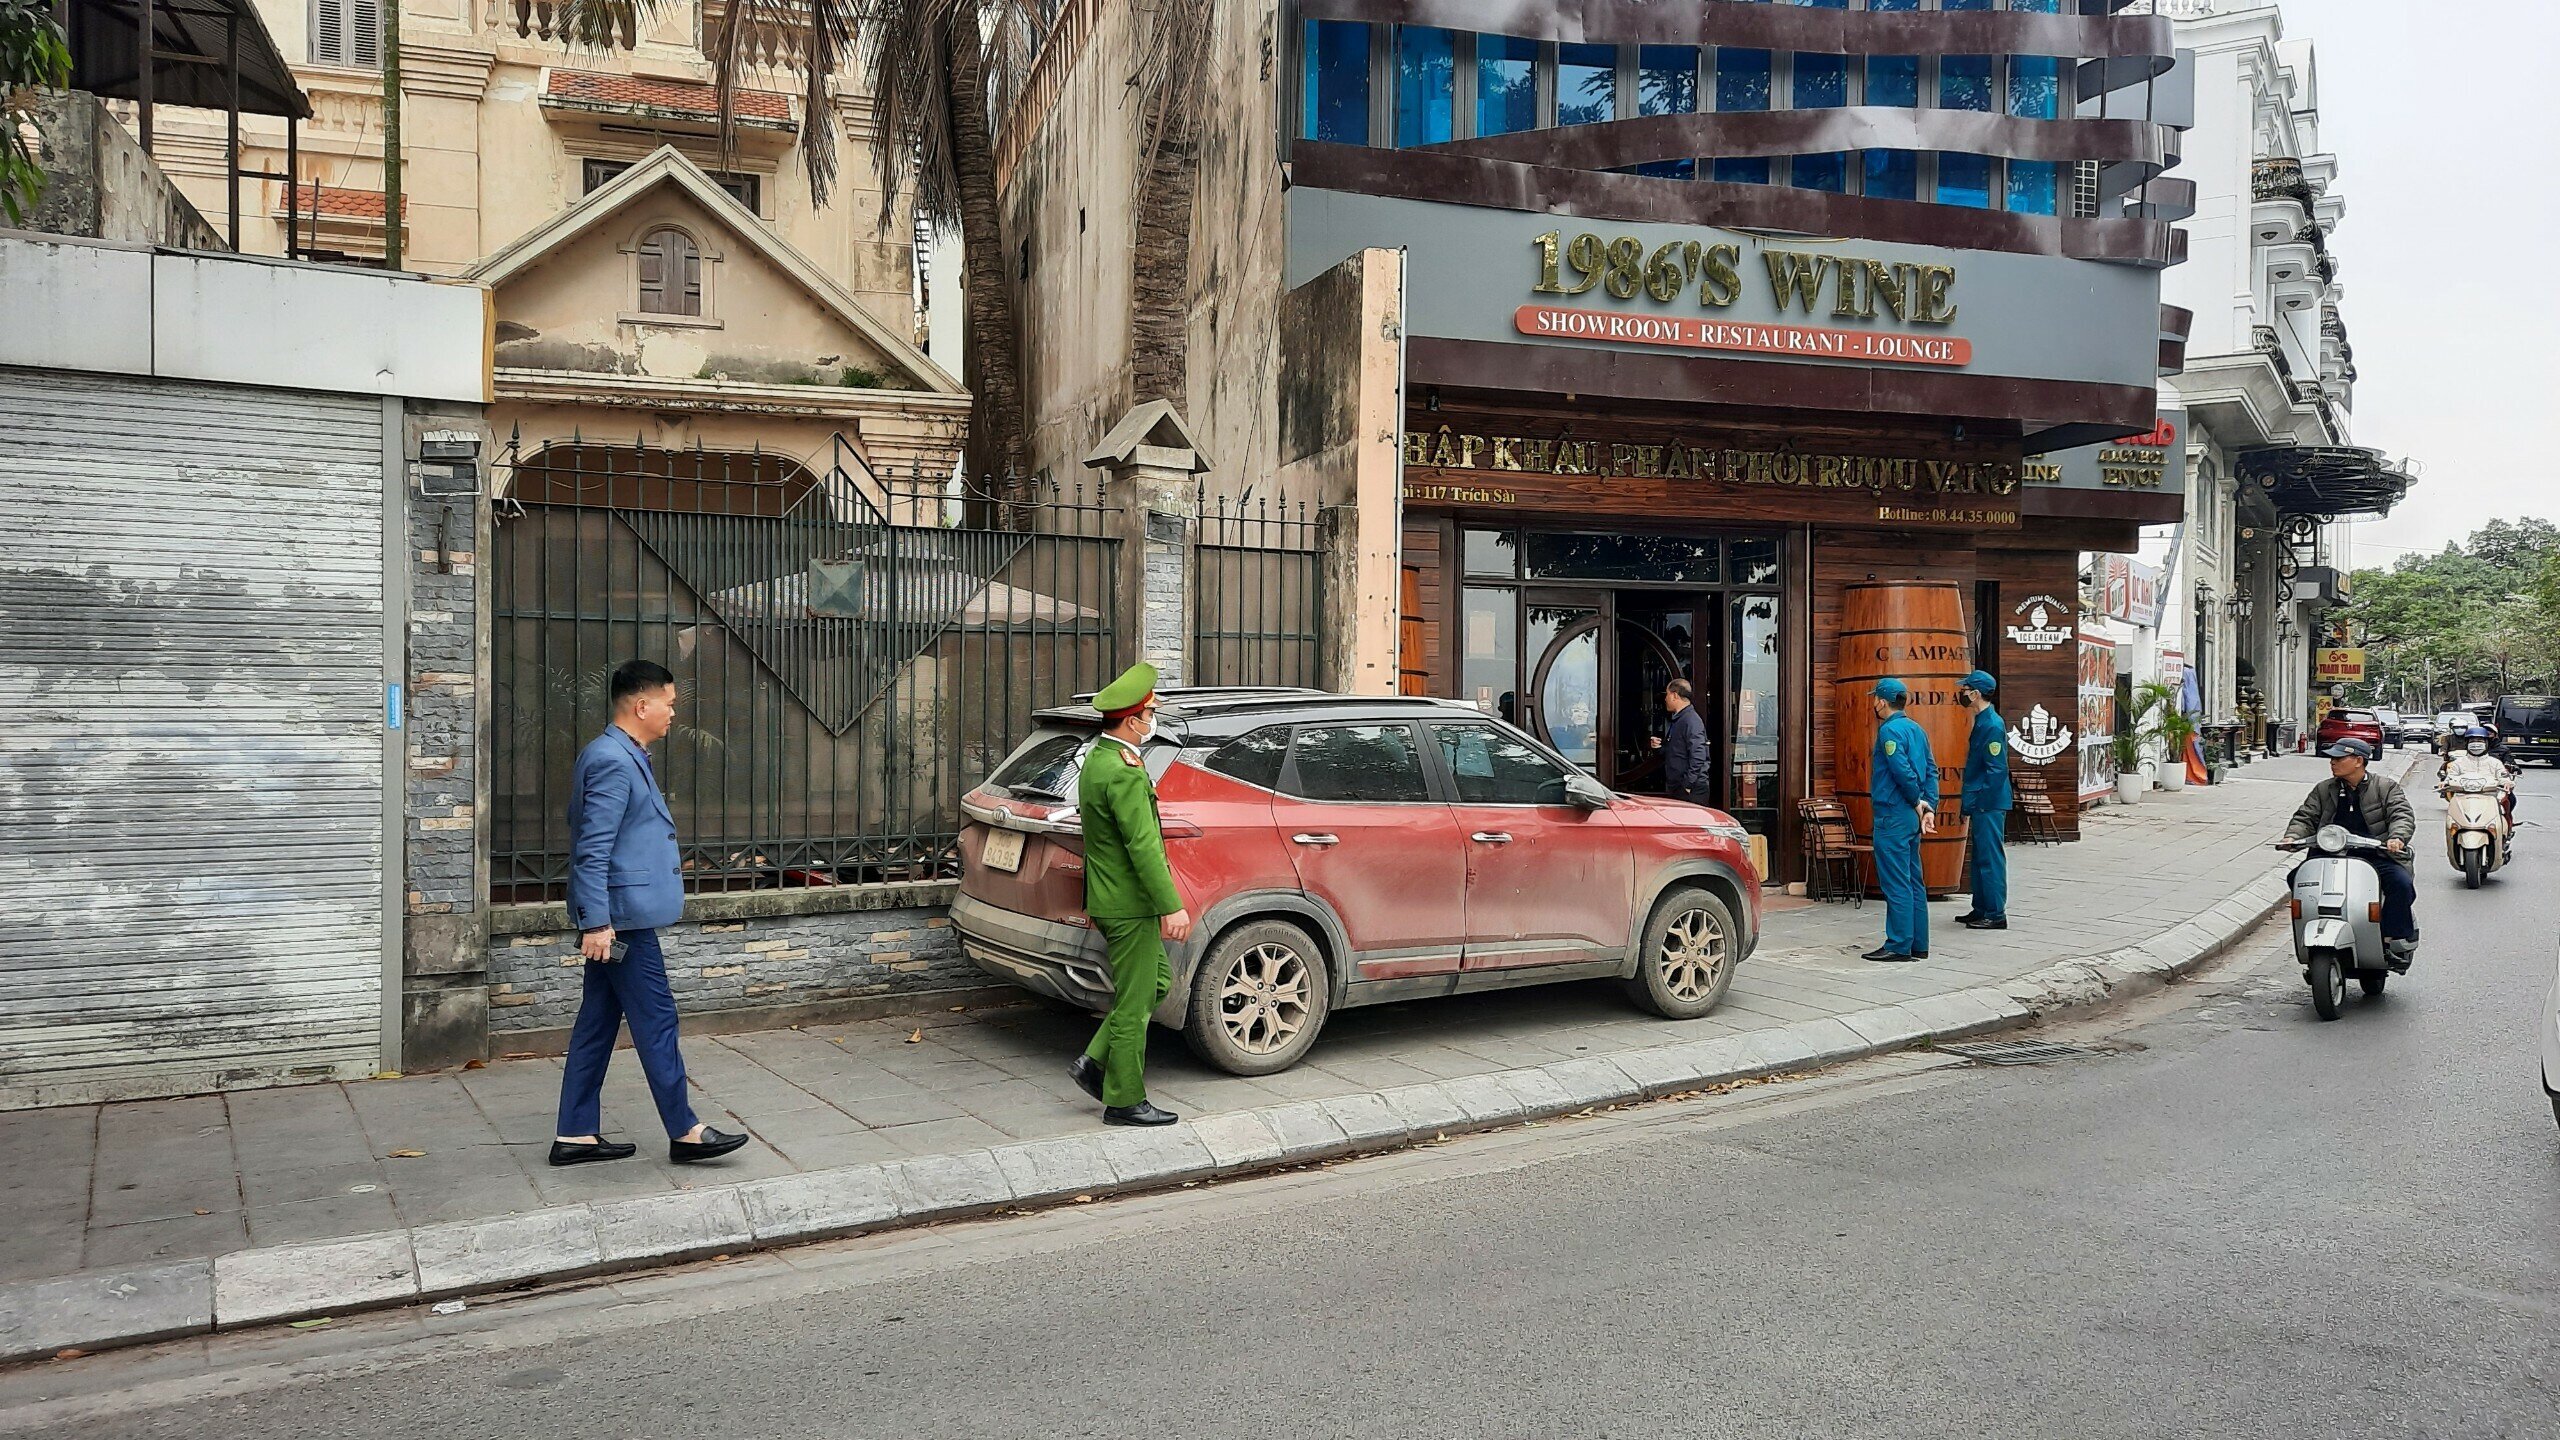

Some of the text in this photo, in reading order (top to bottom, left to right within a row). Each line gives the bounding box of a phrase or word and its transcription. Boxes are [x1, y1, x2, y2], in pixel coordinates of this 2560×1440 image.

[1532, 228, 1959, 324] 1986'S WINE
[1537, 311, 1681, 342] SHOWROOM
[1701, 324, 1847, 353] RESTAURANT
[1865, 335, 1954, 361] LOUNGE
[1403, 424, 1485, 476] HẬP
[1611, 437, 1716, 481] PHÂN
[1926, 459, 2018, 496] VANG
[2022, 463, 2063, 482] INK
[1423, 486, 1447, 500] 117
[1451, 487, 1490, 502] Trích
[1879, 506, 2016, 524] Hotline: 08.44.35.0000
[2044, 595, 2070, 614] QUALITY
[2019, 633, 2060, 642] ICE CREAM
[2016, 741, 2032, 754] ICE
